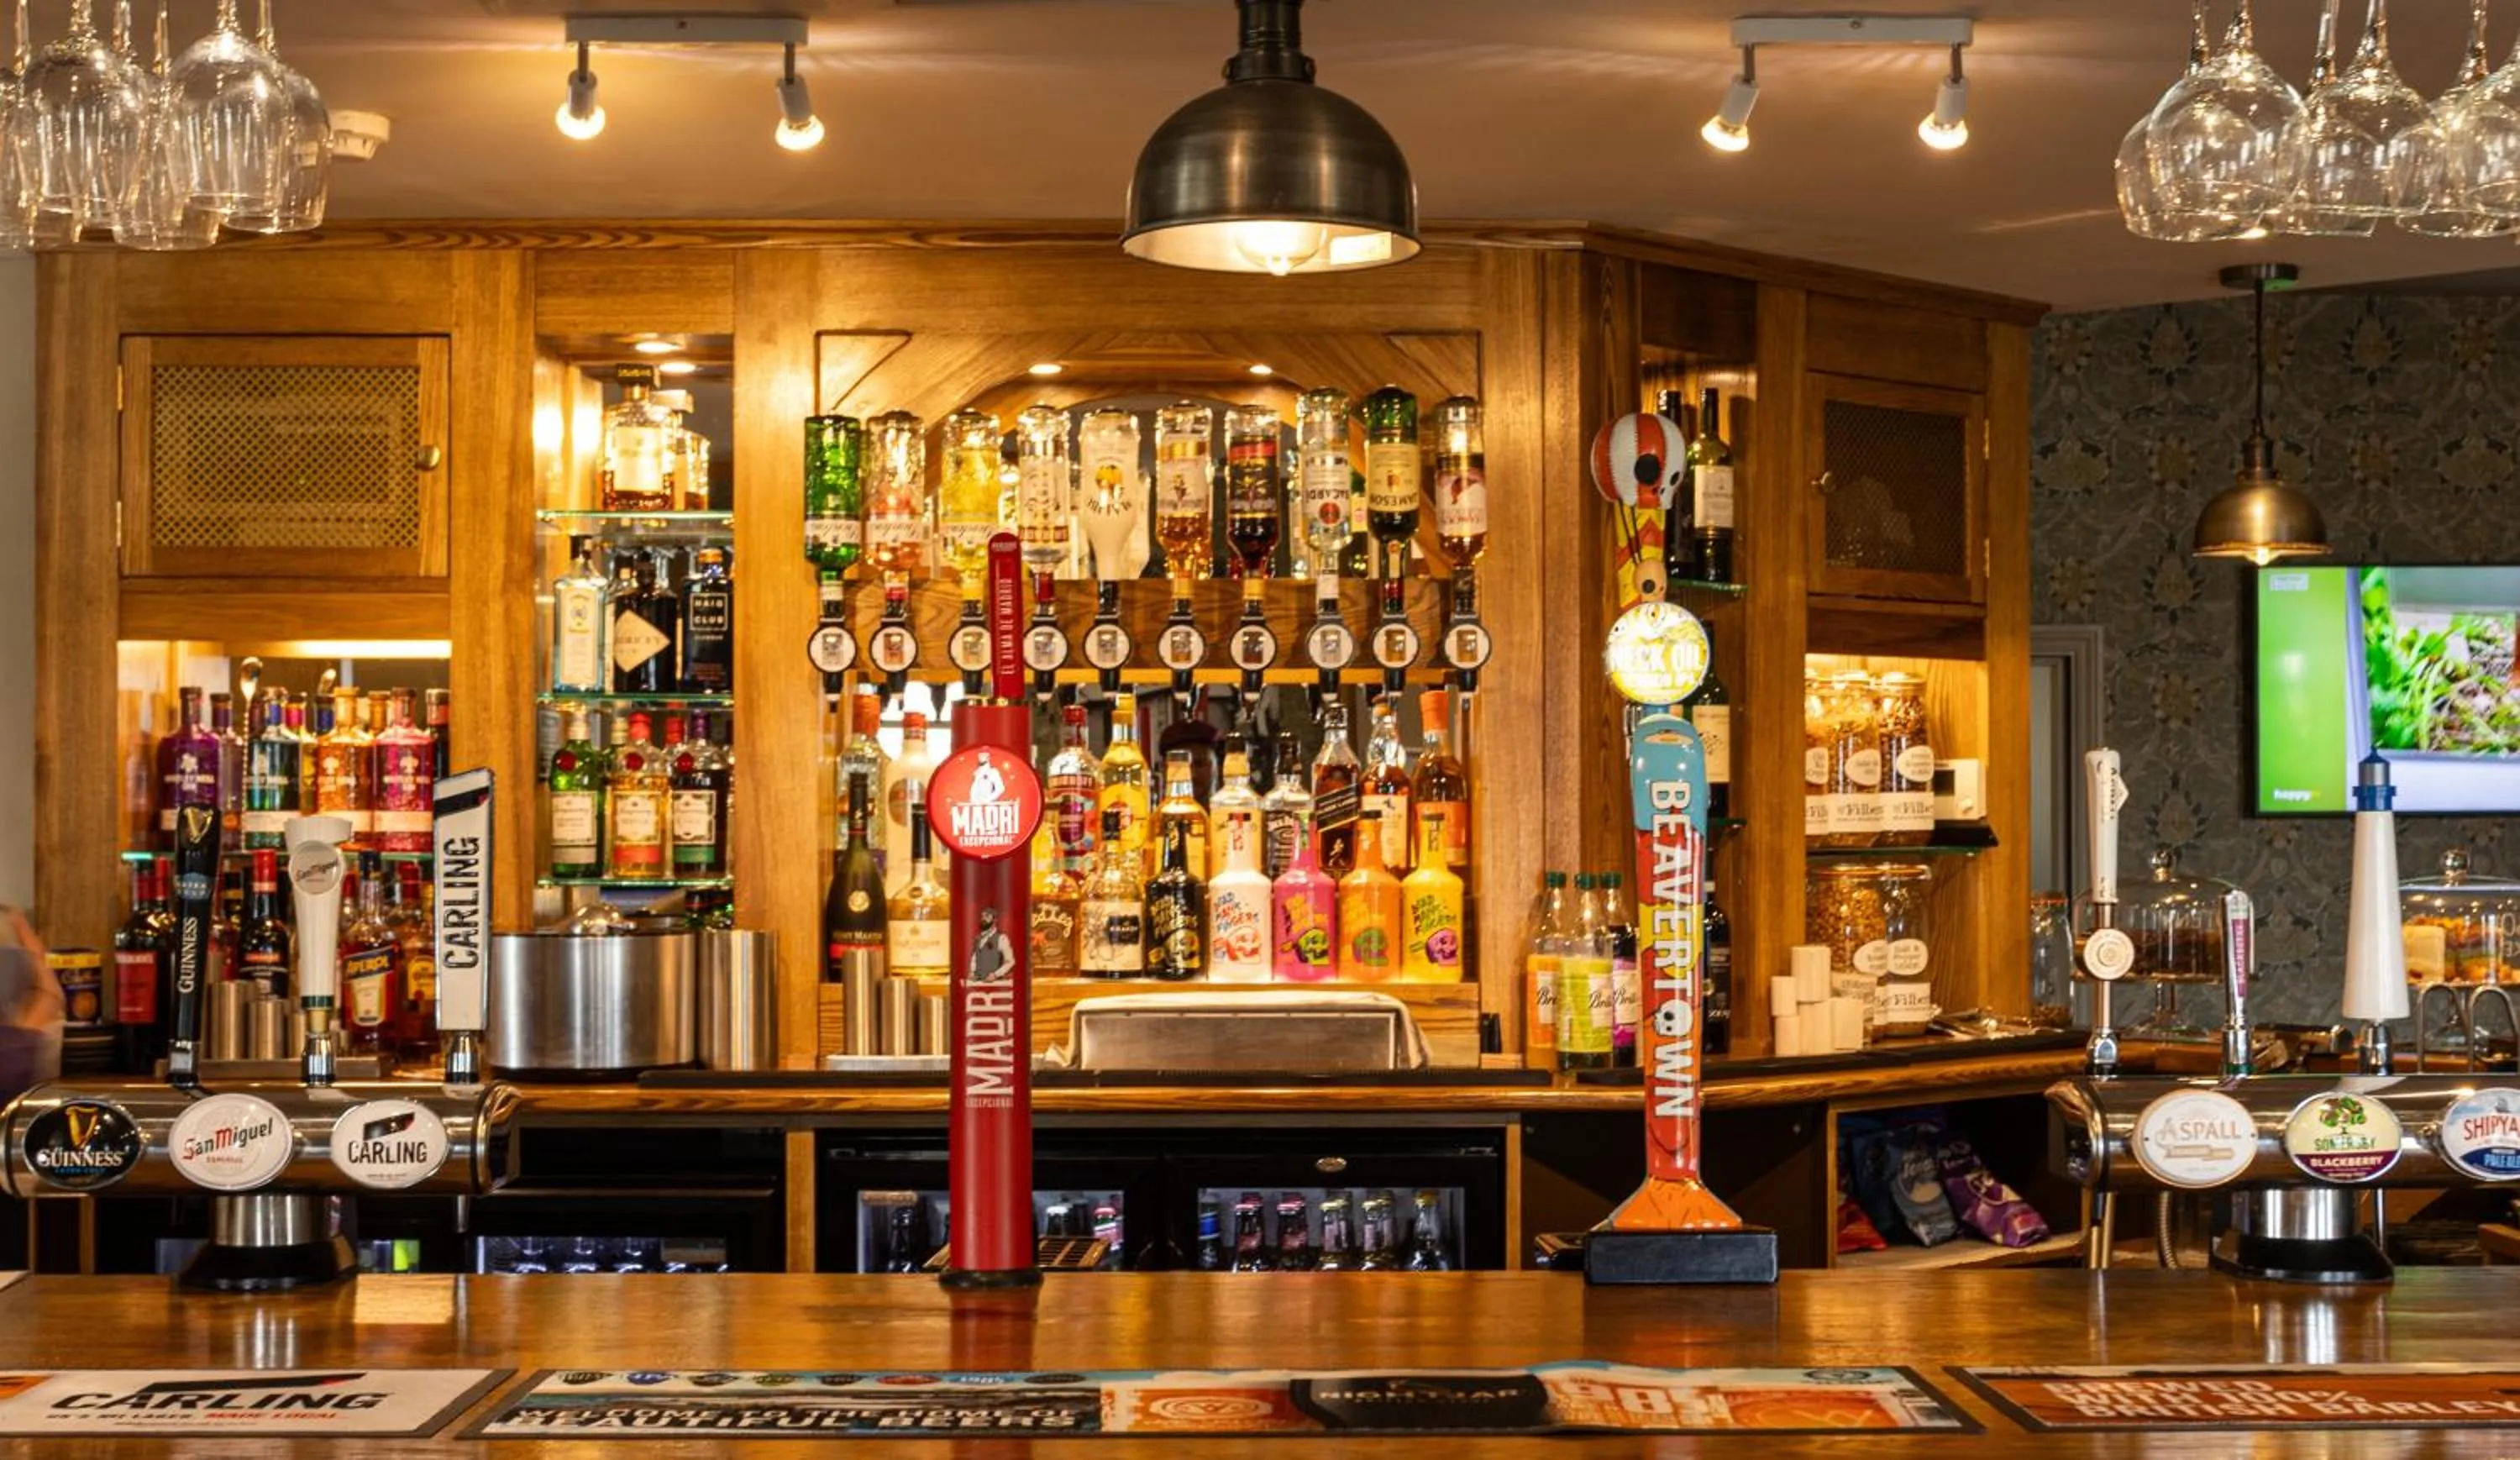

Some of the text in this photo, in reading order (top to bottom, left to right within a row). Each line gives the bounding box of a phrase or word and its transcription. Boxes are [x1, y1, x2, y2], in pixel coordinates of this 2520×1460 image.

[443, 836, 480, 969] CARLING
[178, 916, 198, 994] GUINNESS
[1649, 780, 1695, 1118] BEAVERTOWN
[2155, 1116, 2241, 1142] ASPALL
[36, 1148, 123, 1167] GUINNESS
[348, 1141, 428, 1164] CARLING
[2310, 1156, 2384, 1168] BLACKBERRY
[2043, 1383, 2275, 1394] BREWED
[50, 1392, 393, 1410] CARLING
